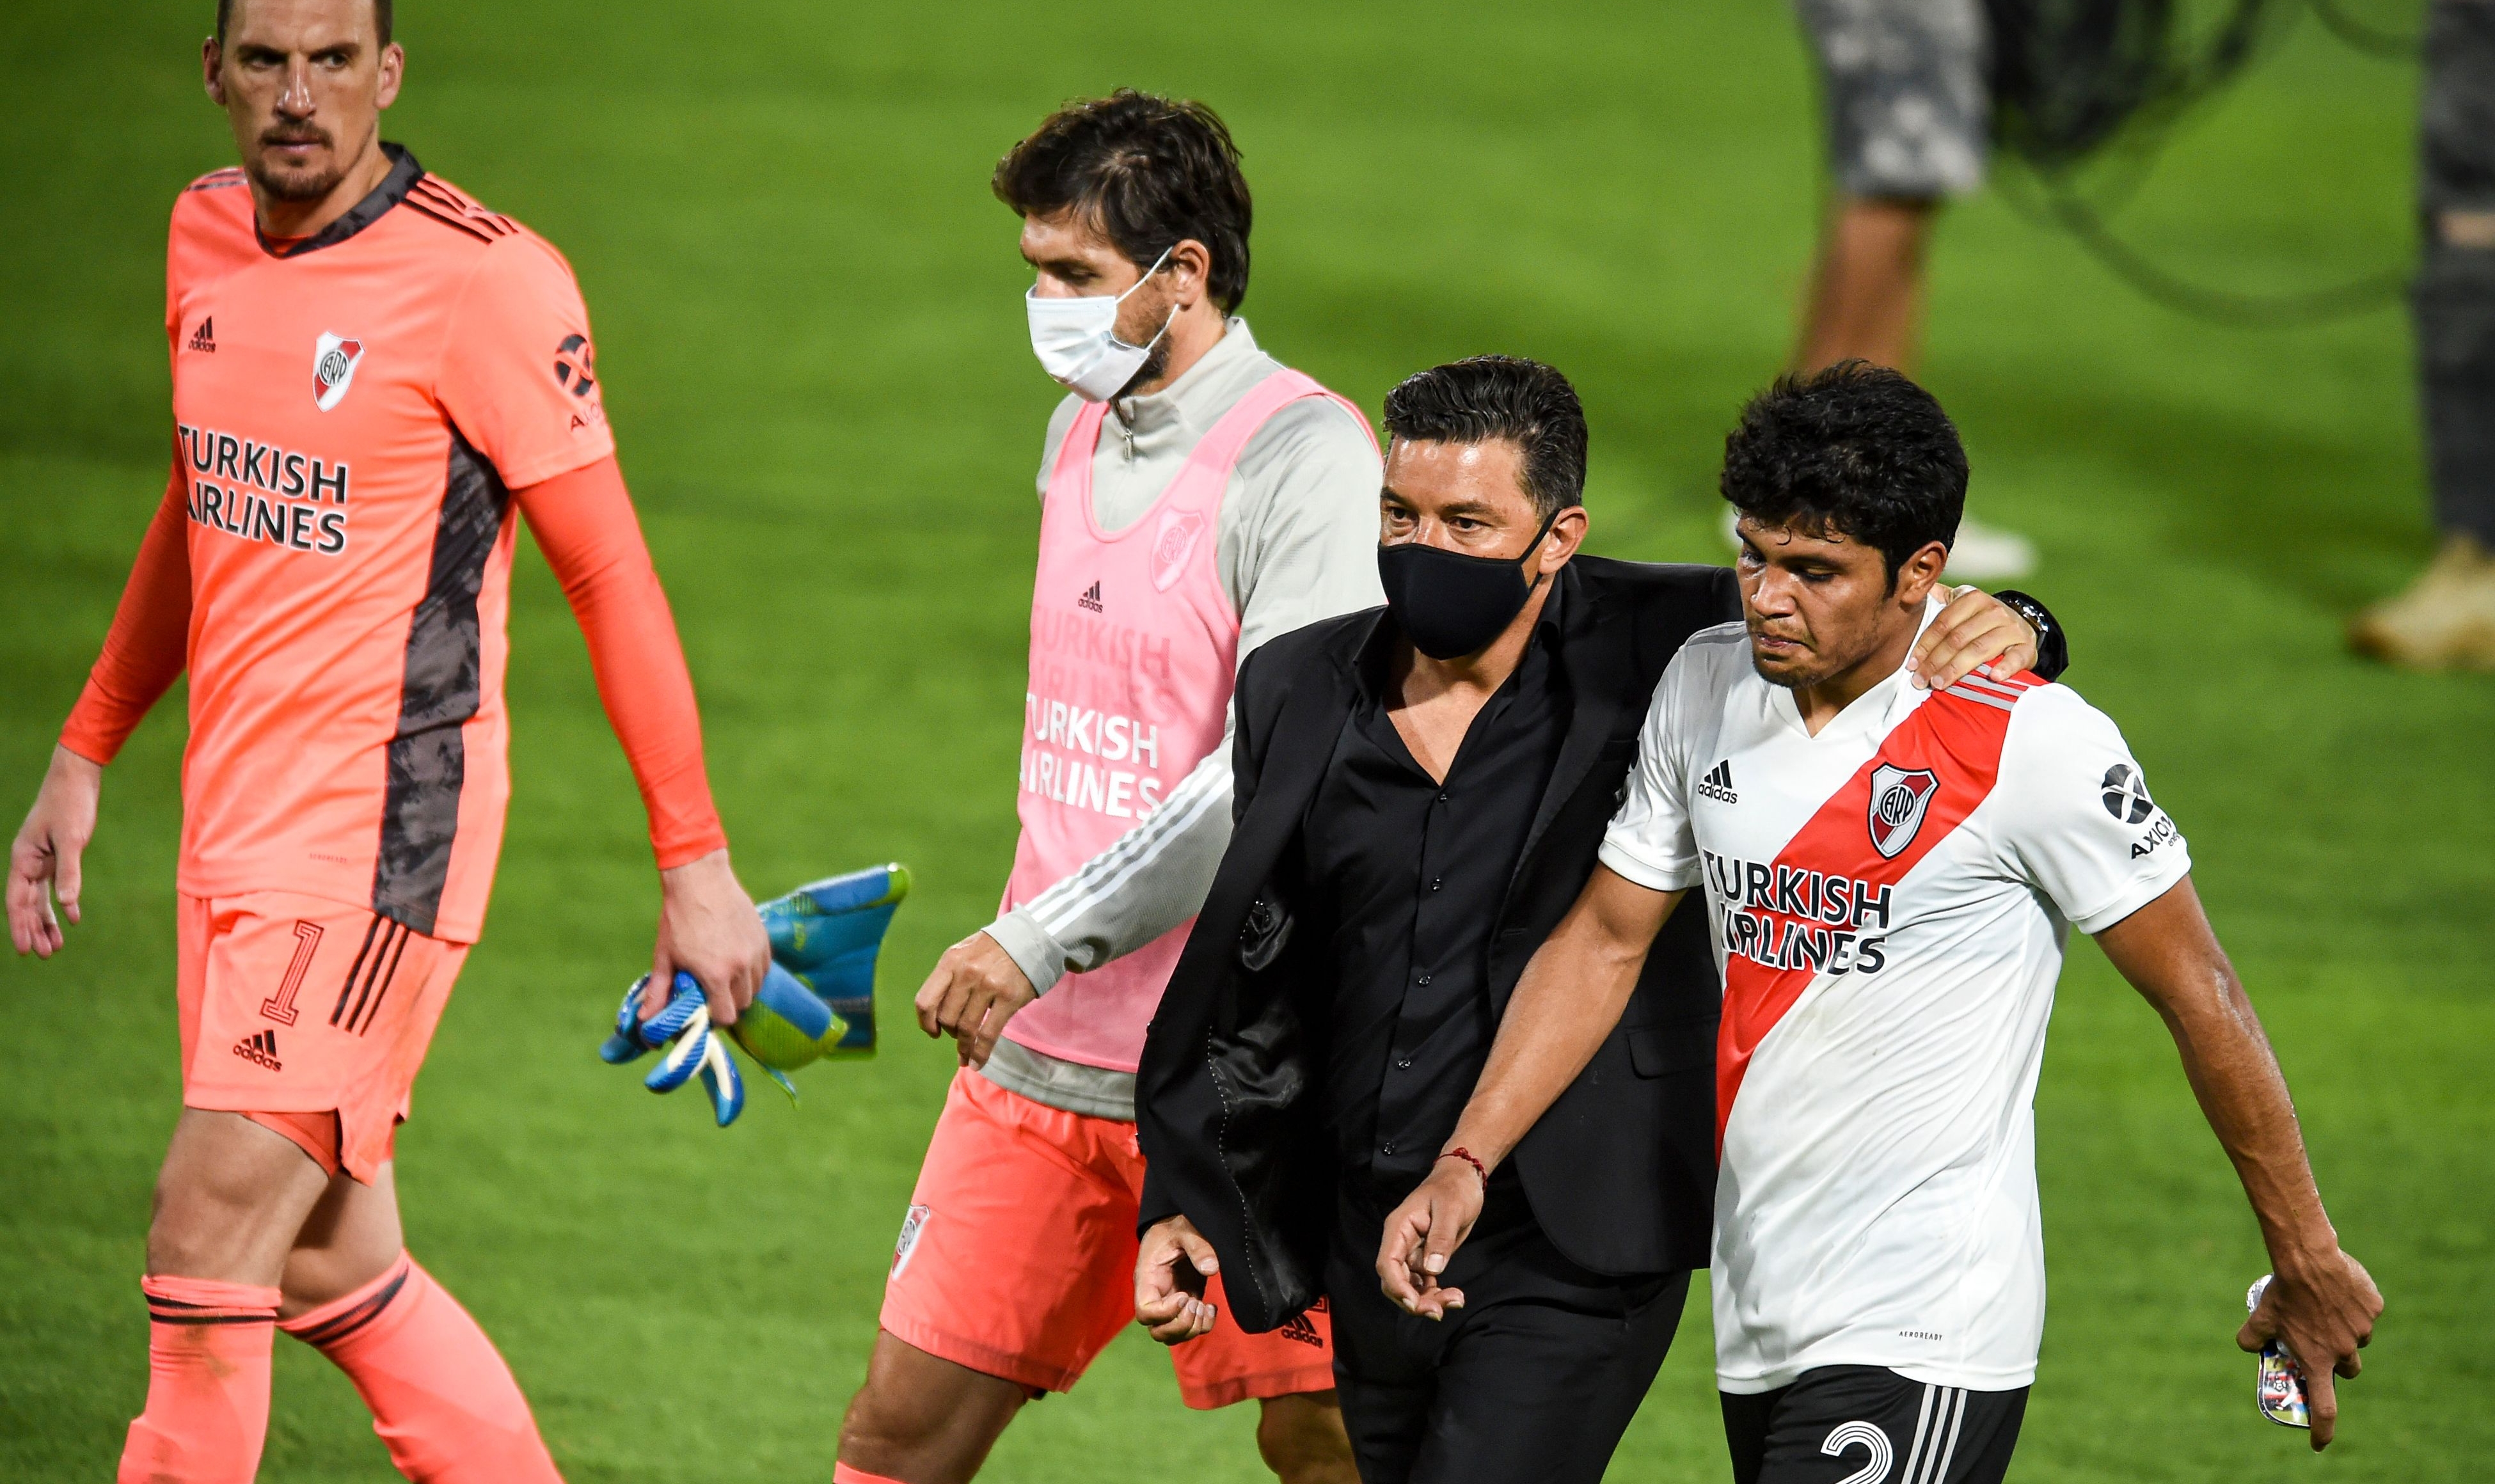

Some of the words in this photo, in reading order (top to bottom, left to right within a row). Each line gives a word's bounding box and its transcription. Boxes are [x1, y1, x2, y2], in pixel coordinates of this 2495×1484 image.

[178, 424, 347, 505] TURKISH
[1077, 596, 1104, 613] adidas
[1698, 783, 1738, 804] adidas
[1702, 848, 1892, 930] TURKISH
[260, 919, 324, 1027] 1
[233, 1043, 282, 1073] adidas
[1281, 1326, 1323, 1349] adidas
[1899, 1330, 1943, 1341] AEROREADY
[1820, 1420, 1894, 1484] 2
